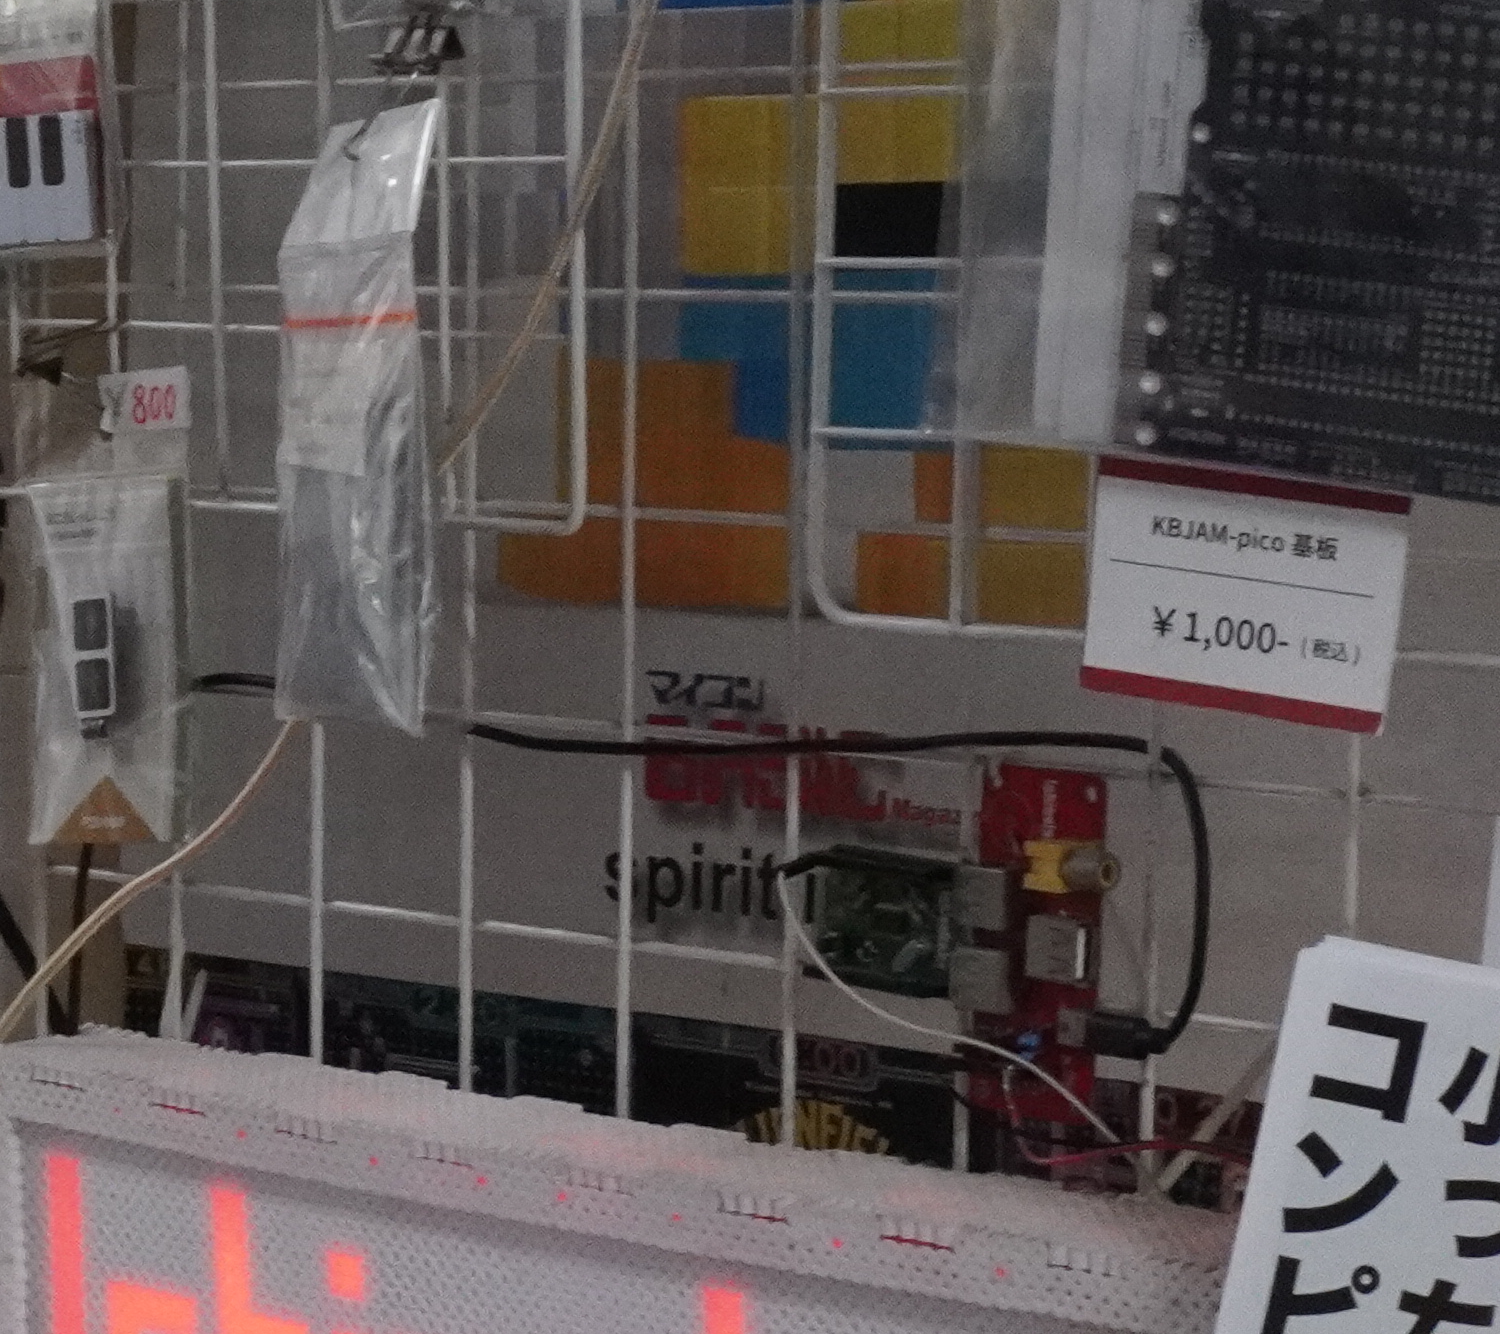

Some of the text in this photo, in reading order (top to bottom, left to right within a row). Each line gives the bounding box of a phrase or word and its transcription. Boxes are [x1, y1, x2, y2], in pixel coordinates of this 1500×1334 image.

[131, 381, 178, 425] 800
[1152, 517, 1339, 560] KBJAM-pico 基板
[1154, 606, 1289, 654] ¥1,000-
[645, 669, 766, 711] マイコン
